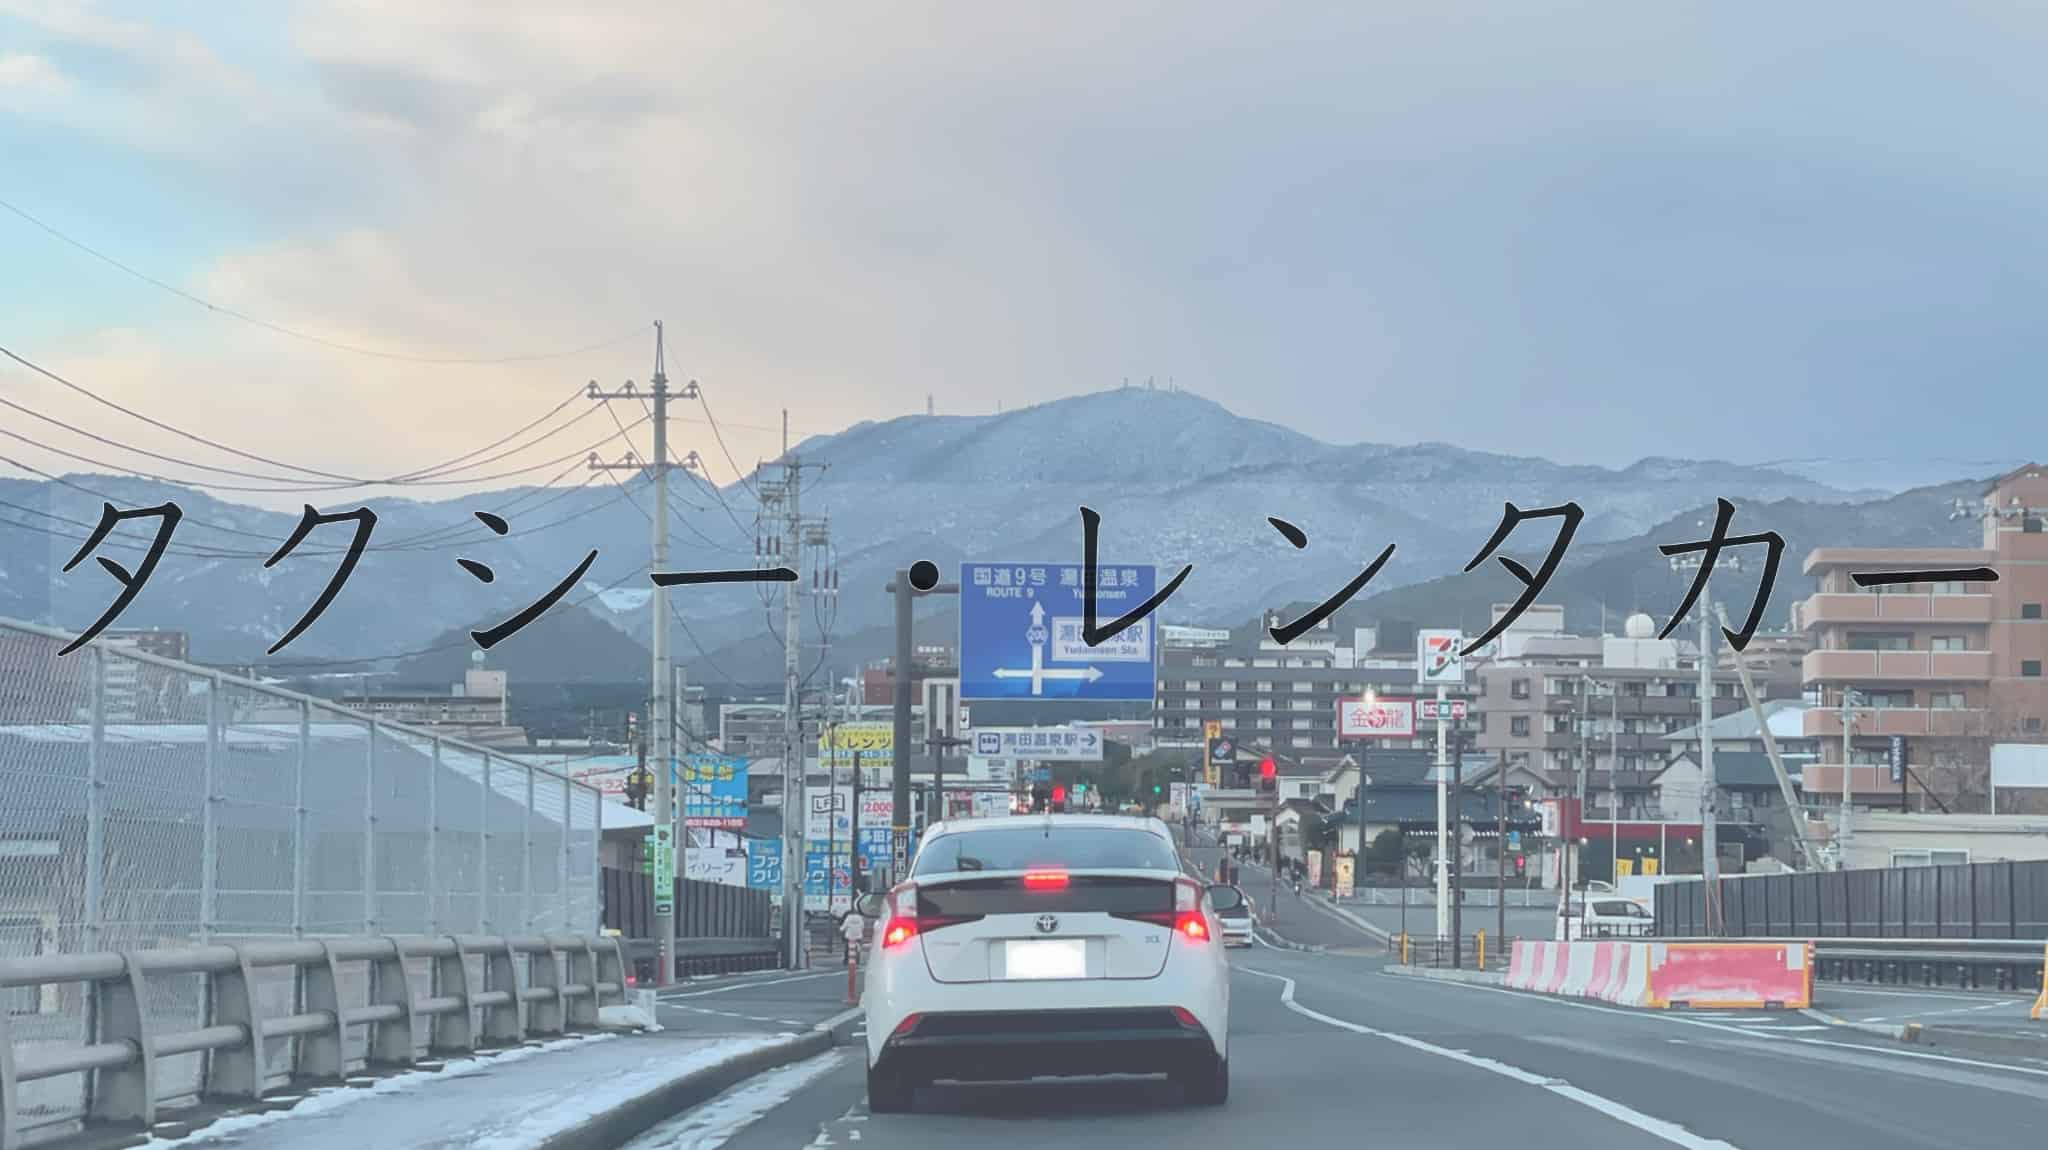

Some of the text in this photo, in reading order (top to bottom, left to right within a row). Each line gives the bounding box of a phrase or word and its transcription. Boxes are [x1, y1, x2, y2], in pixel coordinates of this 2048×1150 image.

[973, 567, 1047, 586] 国道9号
[1060, 567, 1138, 587] 湯温泉
[986, 587, 1034, 598] ROUTE 9
